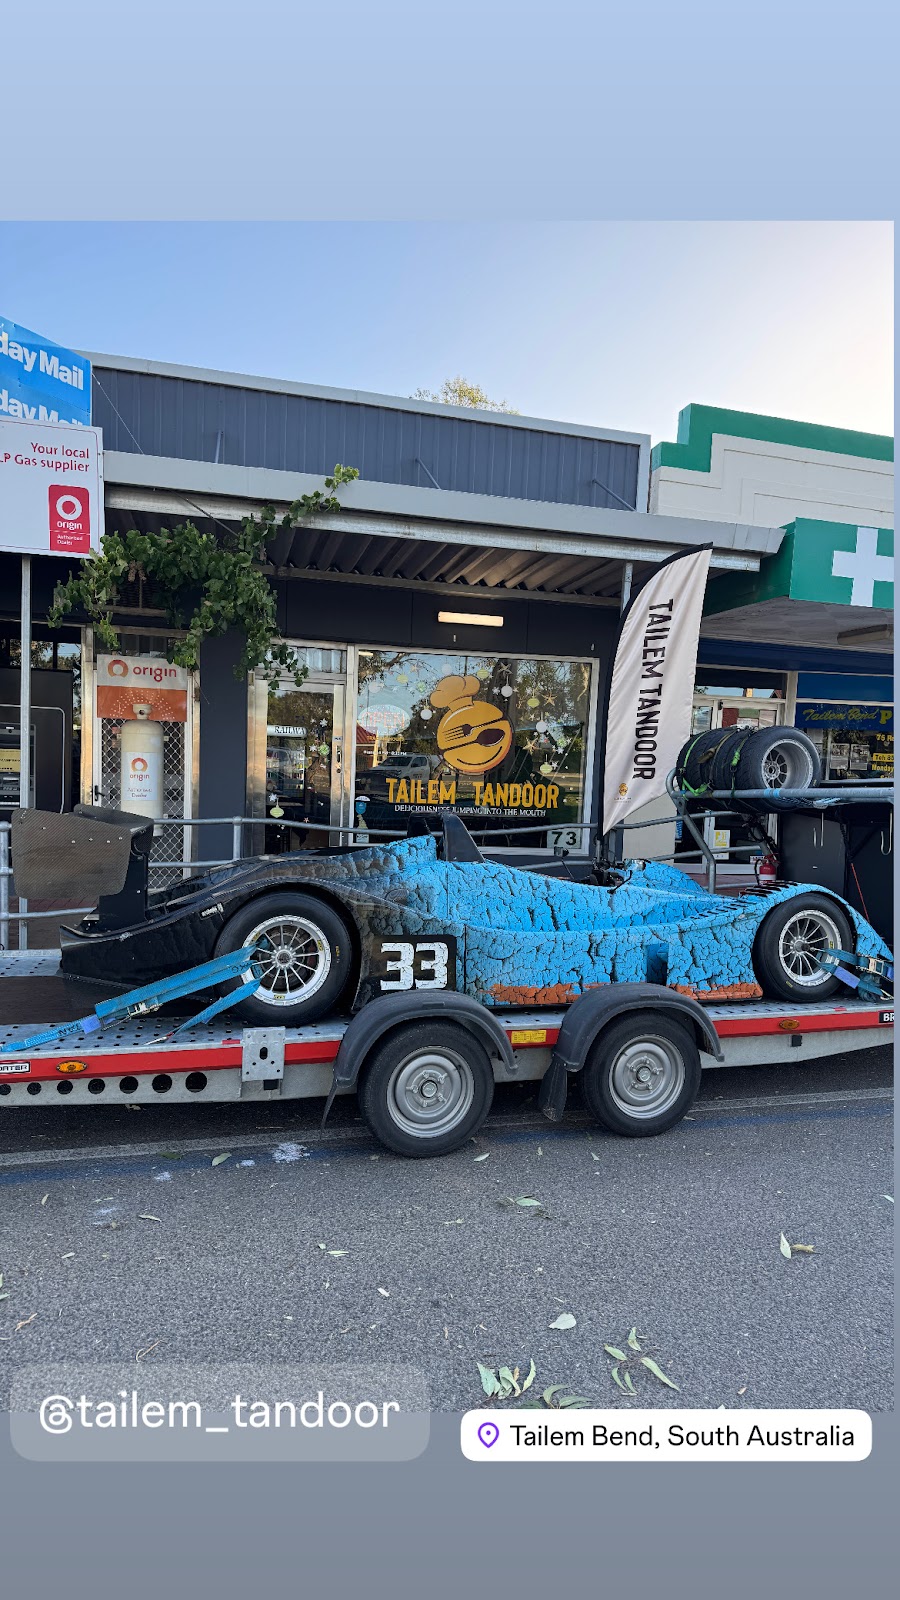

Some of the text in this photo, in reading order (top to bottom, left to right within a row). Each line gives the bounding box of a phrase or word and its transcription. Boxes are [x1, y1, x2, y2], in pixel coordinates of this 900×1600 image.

[40, 349, 84, 391] Mail
[31, 442, 89, 459] Your local
[15, 454, 37, 467] Gas
[41, 459, 90, 473] supplier
[57, 521, 82, 530] origin
[133, 666, 177, 682] origin
[632, 598, 674, 780] TAILEM TANDOOR
[361, 711, 405, 729] OPEN
[803, 708, 846, 722] Tailem
[847, 708, 879, 721] Bend
[386, 778, 560, 809] TAILEM TANDOOR
[483, 807, 502, 815] INTO
[503, 808, 518, 816] THE
[520, 809, 547, 817] MOUTH
[551, 831, 577, 846] 73
[380, 942, 448, 991] 33
